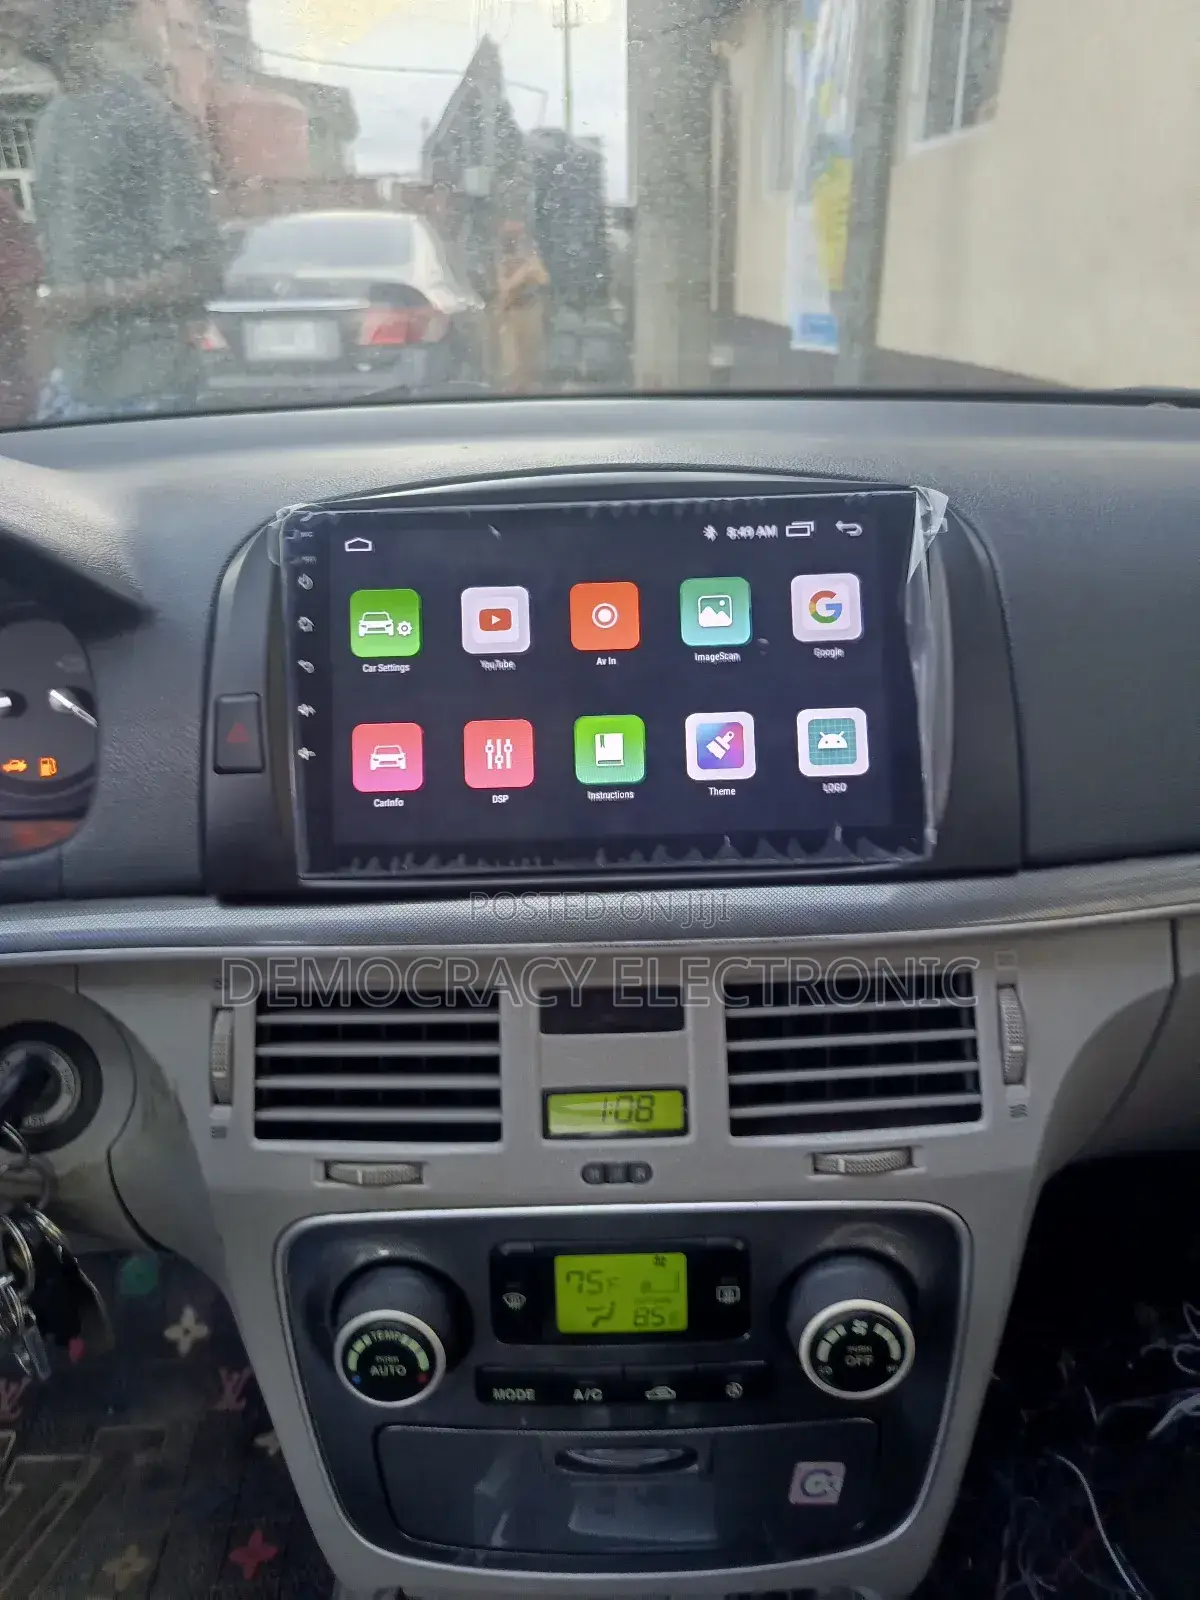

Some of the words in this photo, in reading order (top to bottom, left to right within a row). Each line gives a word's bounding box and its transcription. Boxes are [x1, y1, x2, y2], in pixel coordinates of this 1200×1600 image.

[755, 525, 778, 539] AM
[694, 651, 740, 663] ImageScan
[814, 646, 845, 658] Google
[480, 659, 515, 671] YouTube
[596, 656, 608, 666] Av
[609, 655, 617, 665] In
[362, 664, 377, 673] Car
[377, 663, 410, 674] Settings
[708, 786, 736, 797] Theme
[822, 782, 848, 794] LOGO
[492, 794, 509, 804] DSP
[587, 790, 635, 802] Instructions
[601, 1094, 655, 1124] 1:08
[844, 1354, 873, 1366] OFF
[370, 1364, 407, 1377] AUTO
[493, 1388, 536, 1401] MODE
[573, 1388, 603, 1401] A/C
